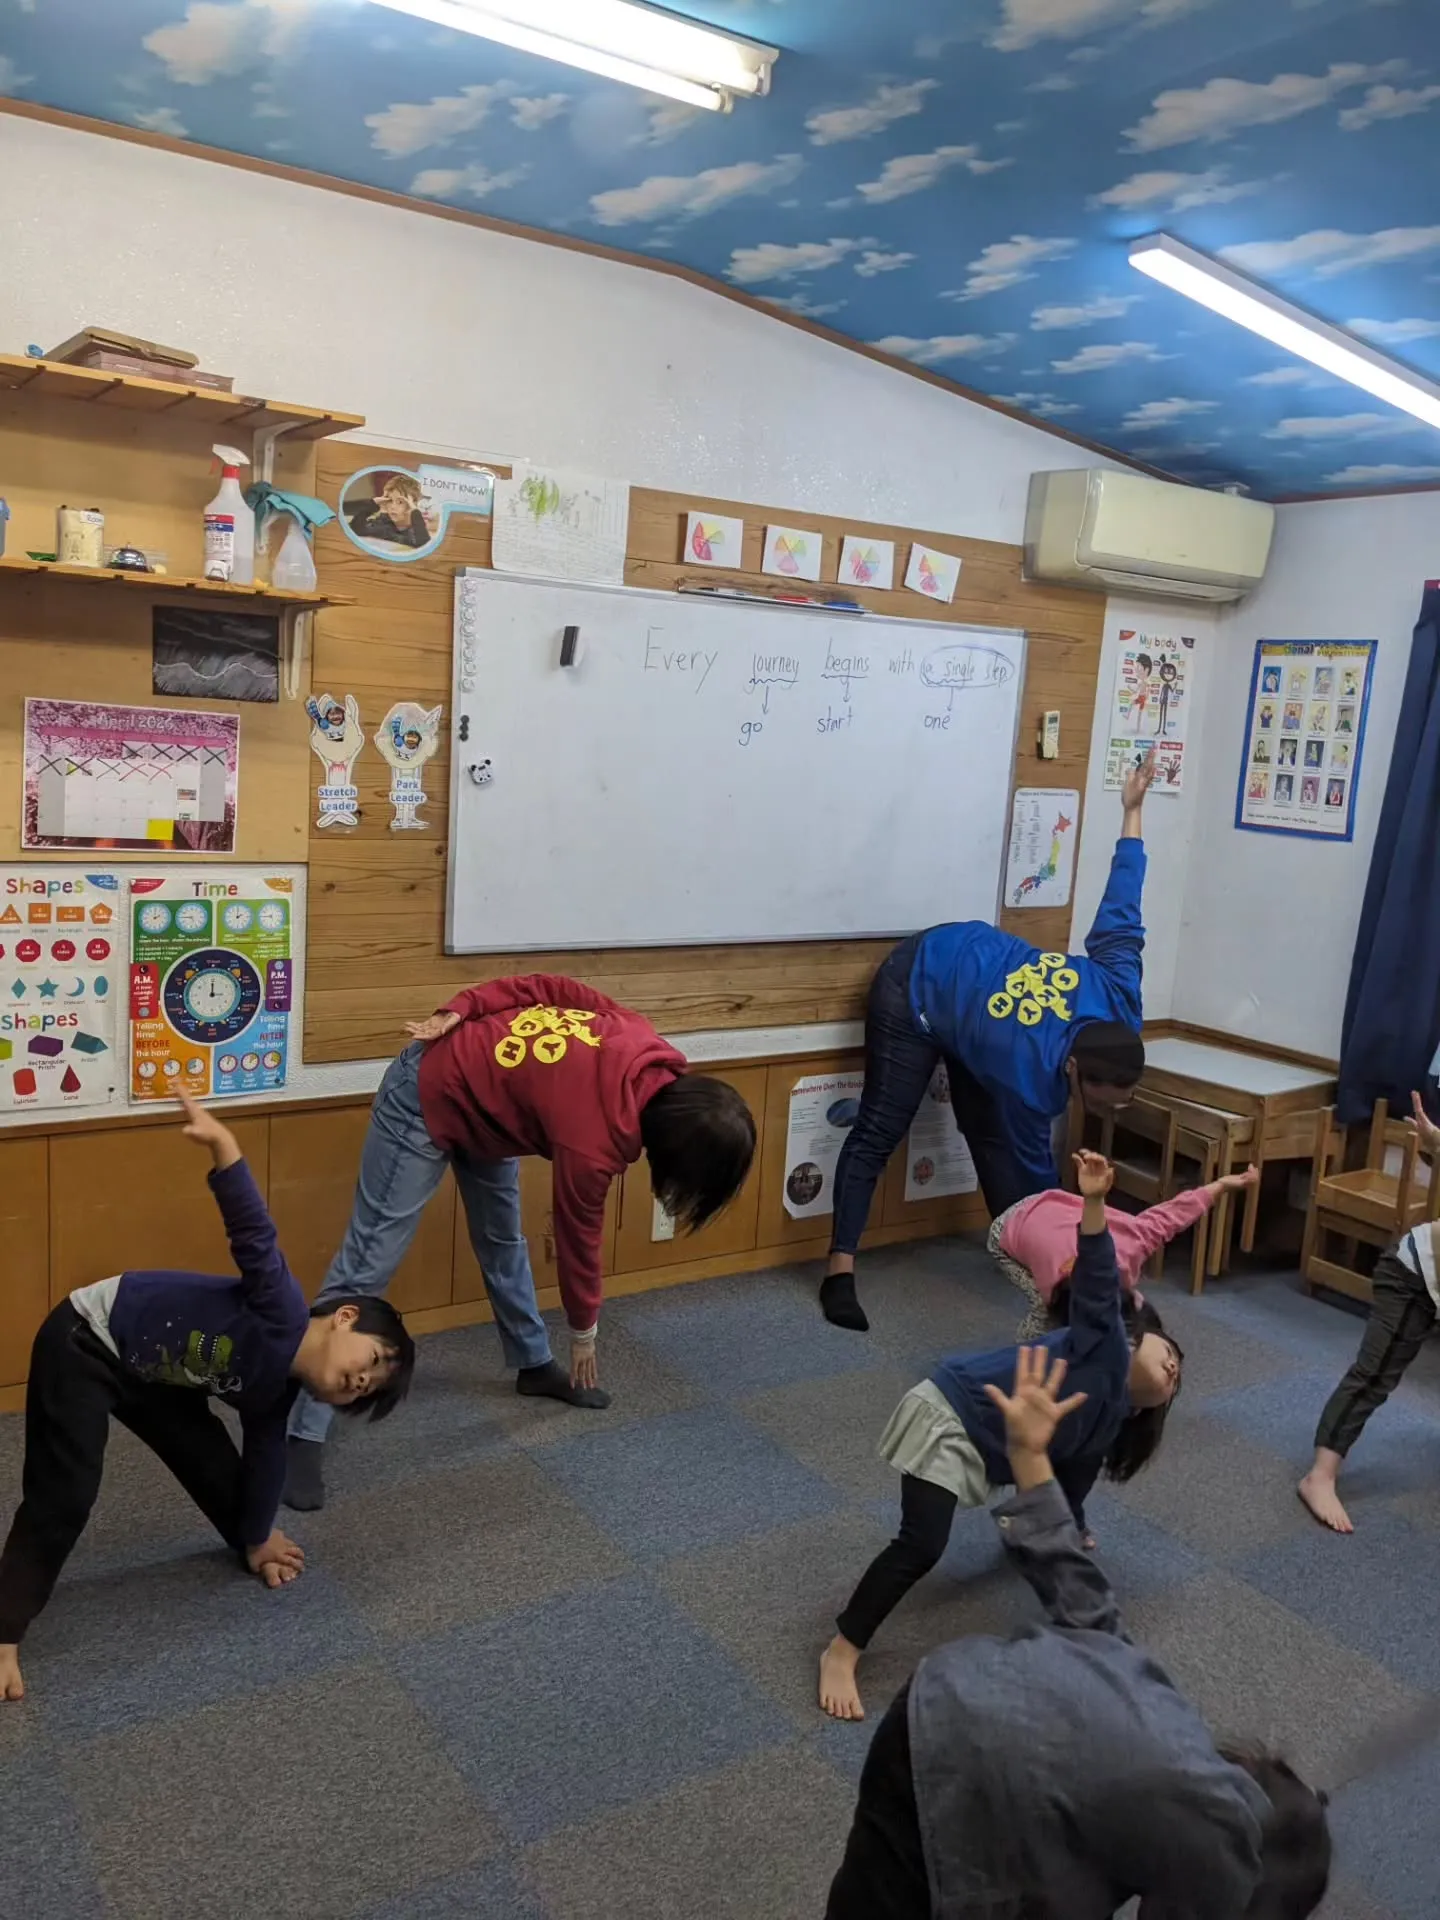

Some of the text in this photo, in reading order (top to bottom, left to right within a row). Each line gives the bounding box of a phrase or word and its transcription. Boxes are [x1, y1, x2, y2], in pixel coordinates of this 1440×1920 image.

[430, 478, 459, 490] DON'T
[644, 626, 718, 694] Every
[825, 637, 870, 684] begins
[889, 648, 915, 675] with
[924, 715, 951, 730] one
[739, 722, 763, 746] go
[396, 779, 418, 789] Park
[319, 787, 356, 797] Stretch
[391, 793, 425, 802] Leader
[320, 801, 356, 811] Leader
[192, 881, 239, 897] Time
[136, 1040, 170, 1049] BEFORE
